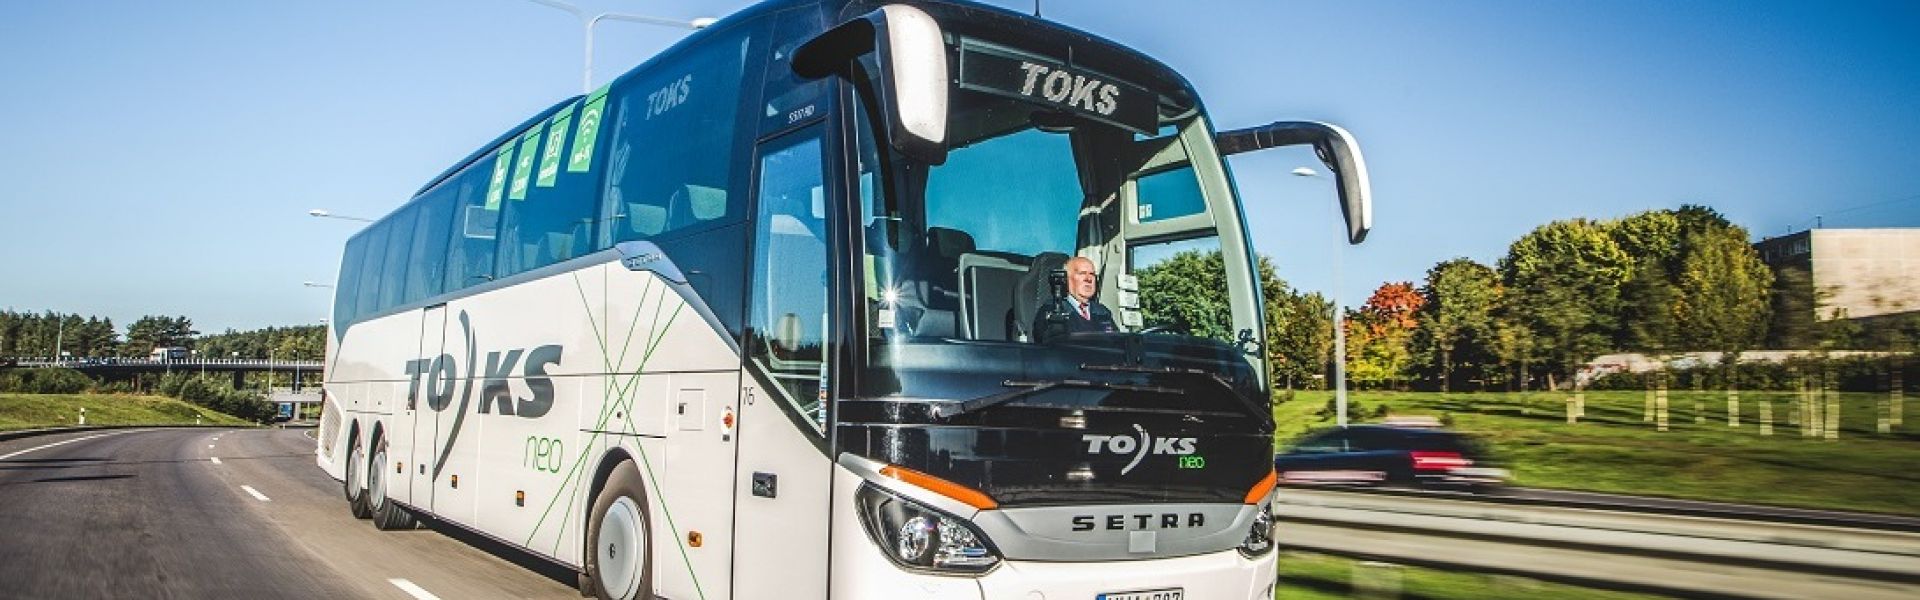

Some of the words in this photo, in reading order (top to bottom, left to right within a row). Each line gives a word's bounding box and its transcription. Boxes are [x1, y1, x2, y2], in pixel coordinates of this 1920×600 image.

[645, 74, 692, 121] TOKS
[1021, 61, 1120, 115] TOKS
[523, 435, 564, 474] neo
[1178, 456, 1206, 470] neo
[1071, 512, 1206, 532] SETRA
